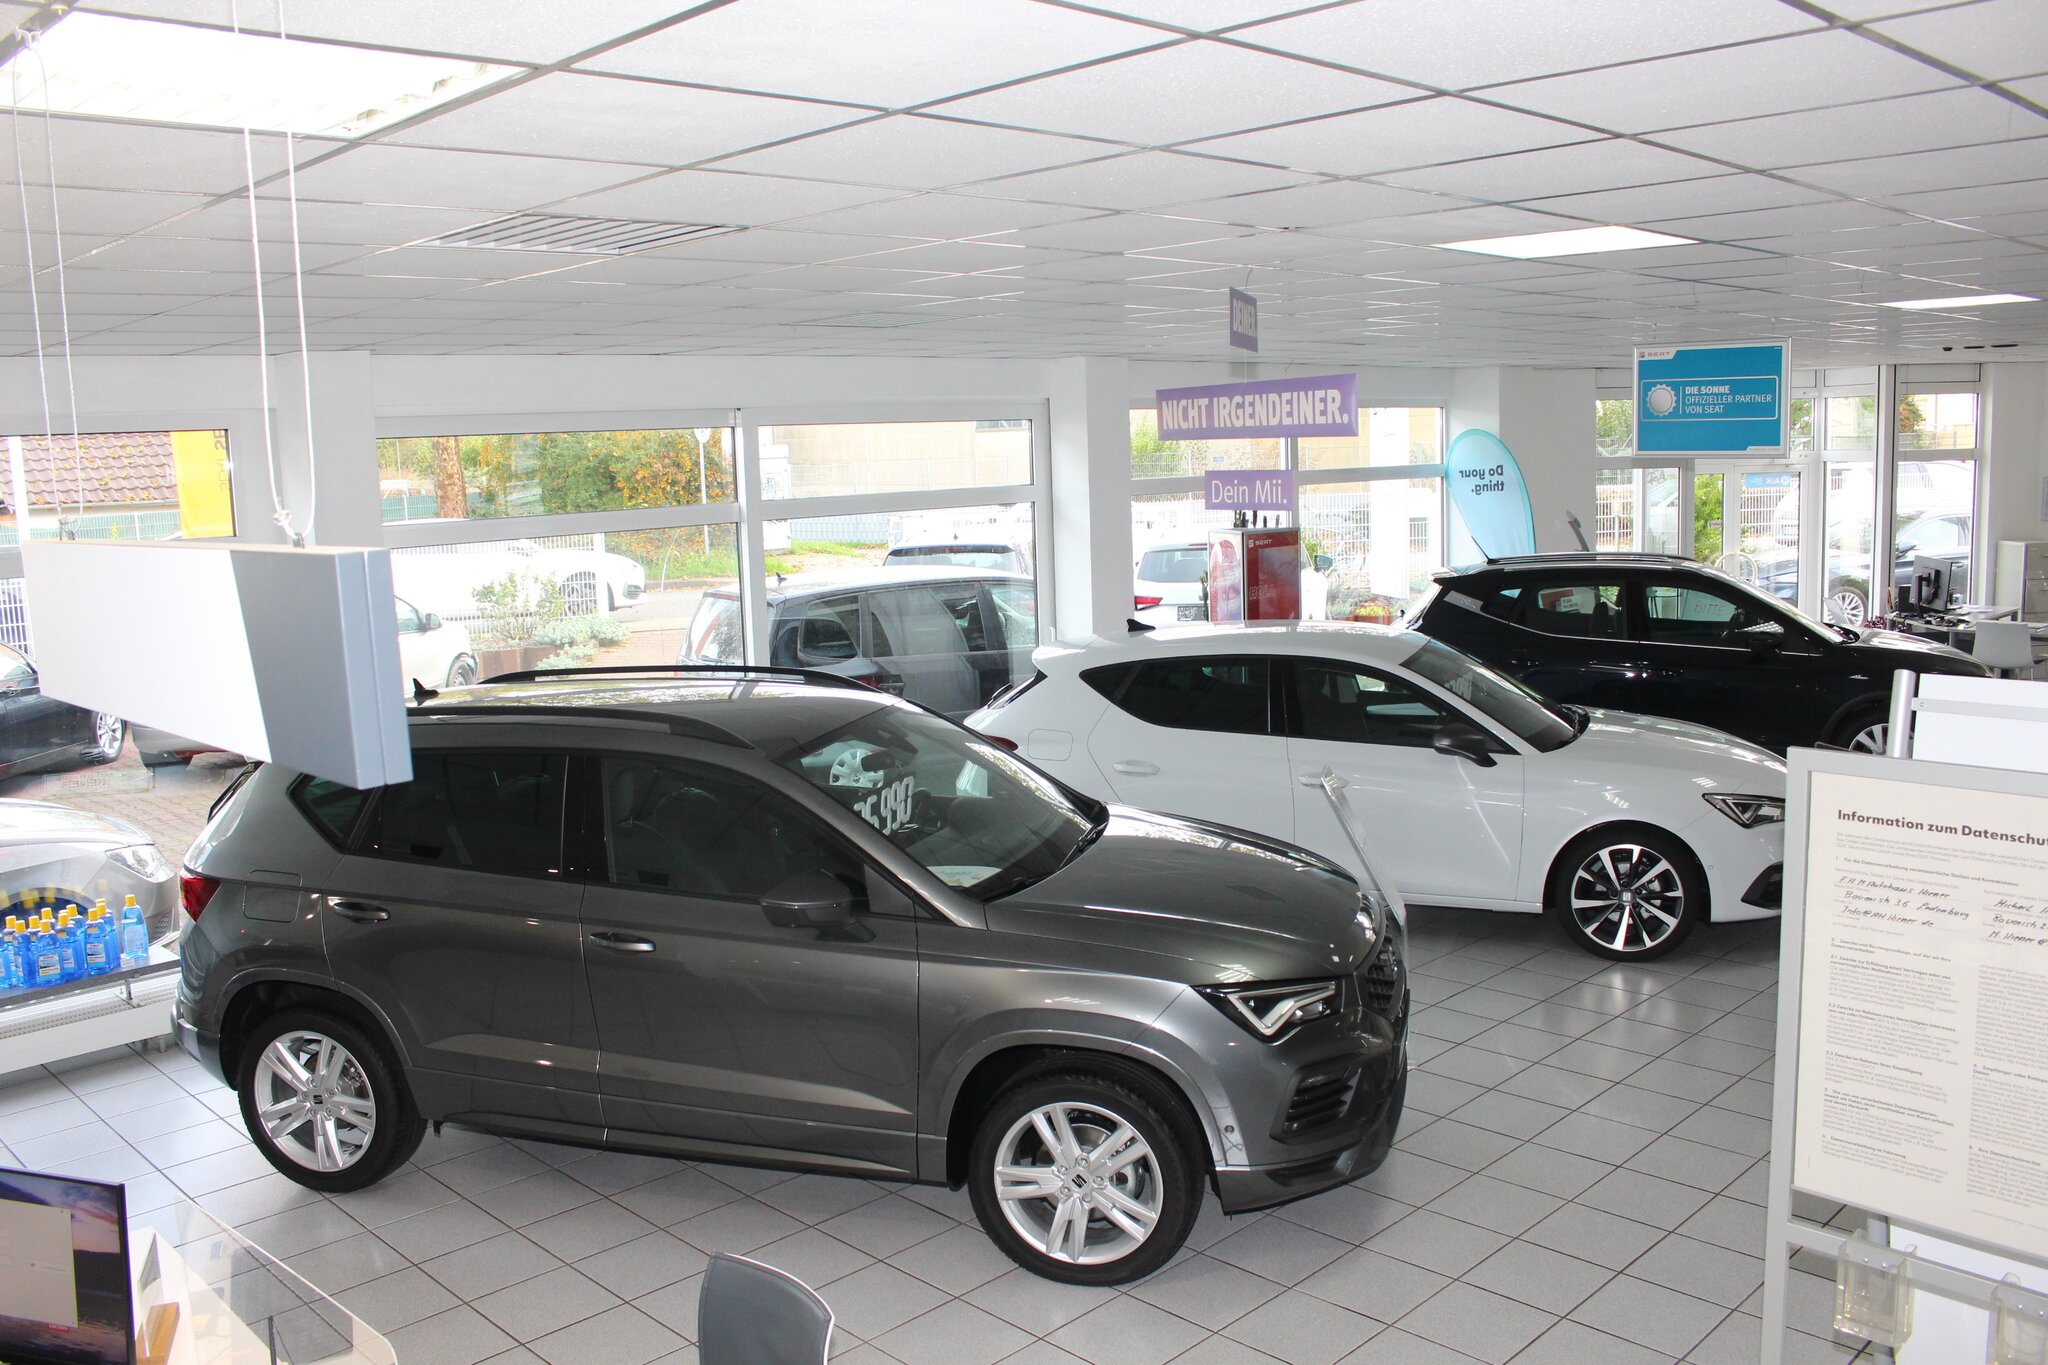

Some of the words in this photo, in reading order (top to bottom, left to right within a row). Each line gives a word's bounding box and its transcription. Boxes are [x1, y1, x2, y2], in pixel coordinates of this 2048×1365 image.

[1685, 386, 1699, 394] DIE
[1700, 385, 1730, 394] SONNE
[1685, 395, 1733, 404] OFFIZIELLER
[1735, 394, 1772, 403] PARTNER
[1162, 398, 1209, 430] NICHT
[1213, 389, 1349, 428] IRGENDEINER.
[1685, 405, 1703, 414] VON
[1704, 405, 1724, 413] SEAT
[1211, 480, 1249, 503] Dein
[1255, 479, 1288, 504] Mii.
[1837, 809, 1924, 831] Information
[1927, 822, 1959, 835] zum
